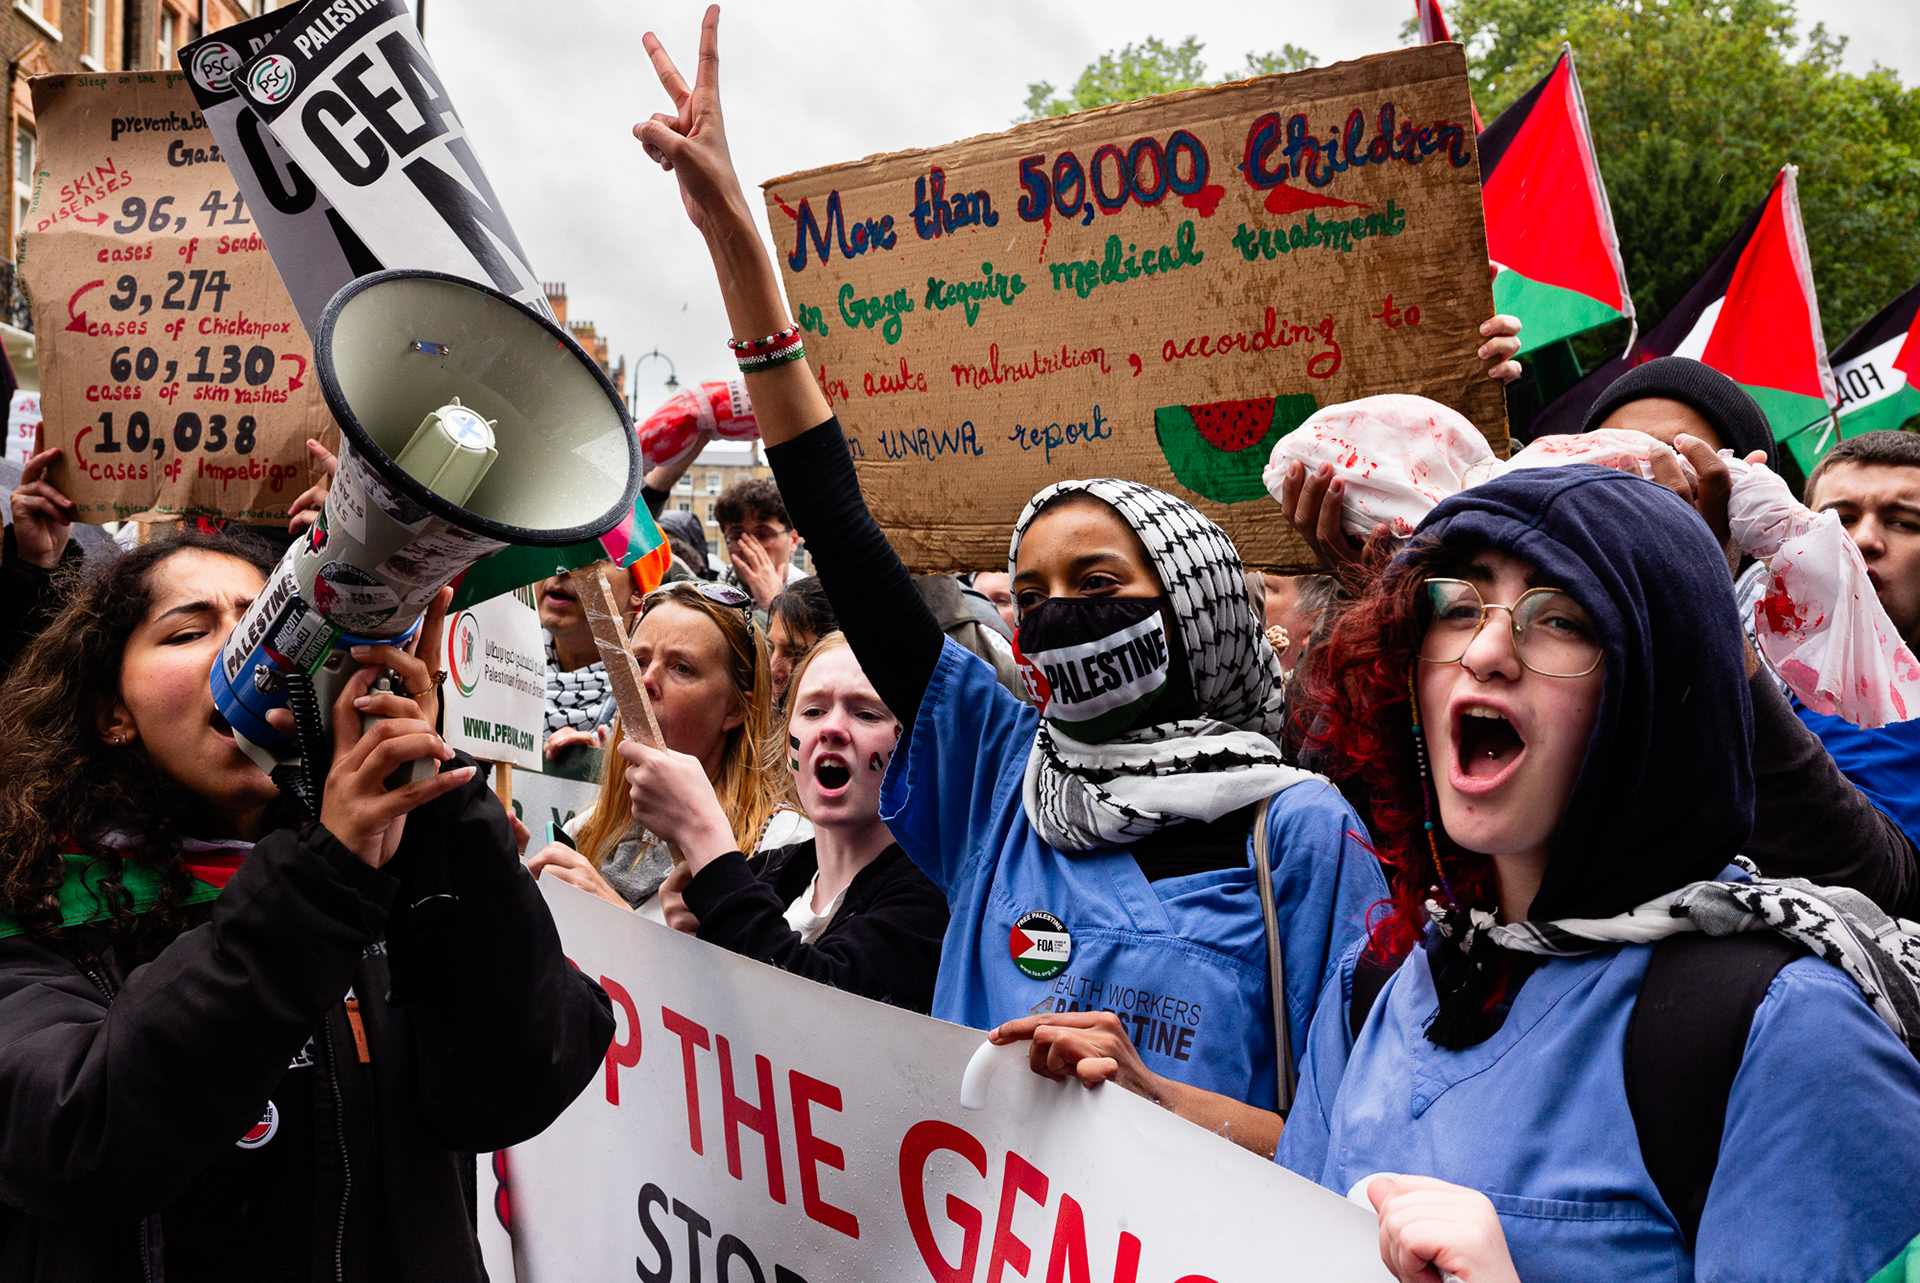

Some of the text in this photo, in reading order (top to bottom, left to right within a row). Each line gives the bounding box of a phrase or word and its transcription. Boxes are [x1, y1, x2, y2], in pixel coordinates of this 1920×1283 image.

[78, 76, 107, 91] sleep
[137, 74, 156, 84] the
[202, 56, 234, 79] PSC
[259, 65, 288, 94] PSC
[167, 139, 226, 167] Gaz
[37, 170, 132, 232] DISEASES
[61, 157, 117, 203] SKIN
[788, 101, 1472, 273] More than 50,000 Children
[113, 189, 250, 234] 96,41
[97, 242, 153, 264] cases
[178, 236, 199, 264] of
[109, 268, 231, 317] 9,274
[799, 303, 829, 338] in
[838, 283, 915, 345] Gaza
[1050, 219, 1205, 299] medical
[1232, 199, 1406, 262] treatment
[87, 311, 291, 341] cases of Chickenpox
[109, 345, 275, 386] 60,130
[819, 364, 851, 408] for
[863, 357, 928, 397] acute
[1162, 306, 1342, 379] according
[1372, 293, 1421, 328] to
[86, 382, 289, 405] cases of skin rashes
[95, 410, 257, 460] 10,038
[878, 420, 984, 462] UNRWA
[1008, 405, 1112, 465] report
[89, 457, 298, 493] cases of Impetigo
[112, 501, 150, 519] hygiene
[299, 624, 334, 670] APARTHEID
[1043, 626, 1168, 706] PALESTINE
[1016, 912, 1064, 931] FREE PALESTINE
[1037, 938, 1054, 952] FOA
[1020, 963, 1058, 978] www.foa.org.uk
[1108, 983, 1202, 1027] WORKERS
[662, 1005, 860, 1240] THE
